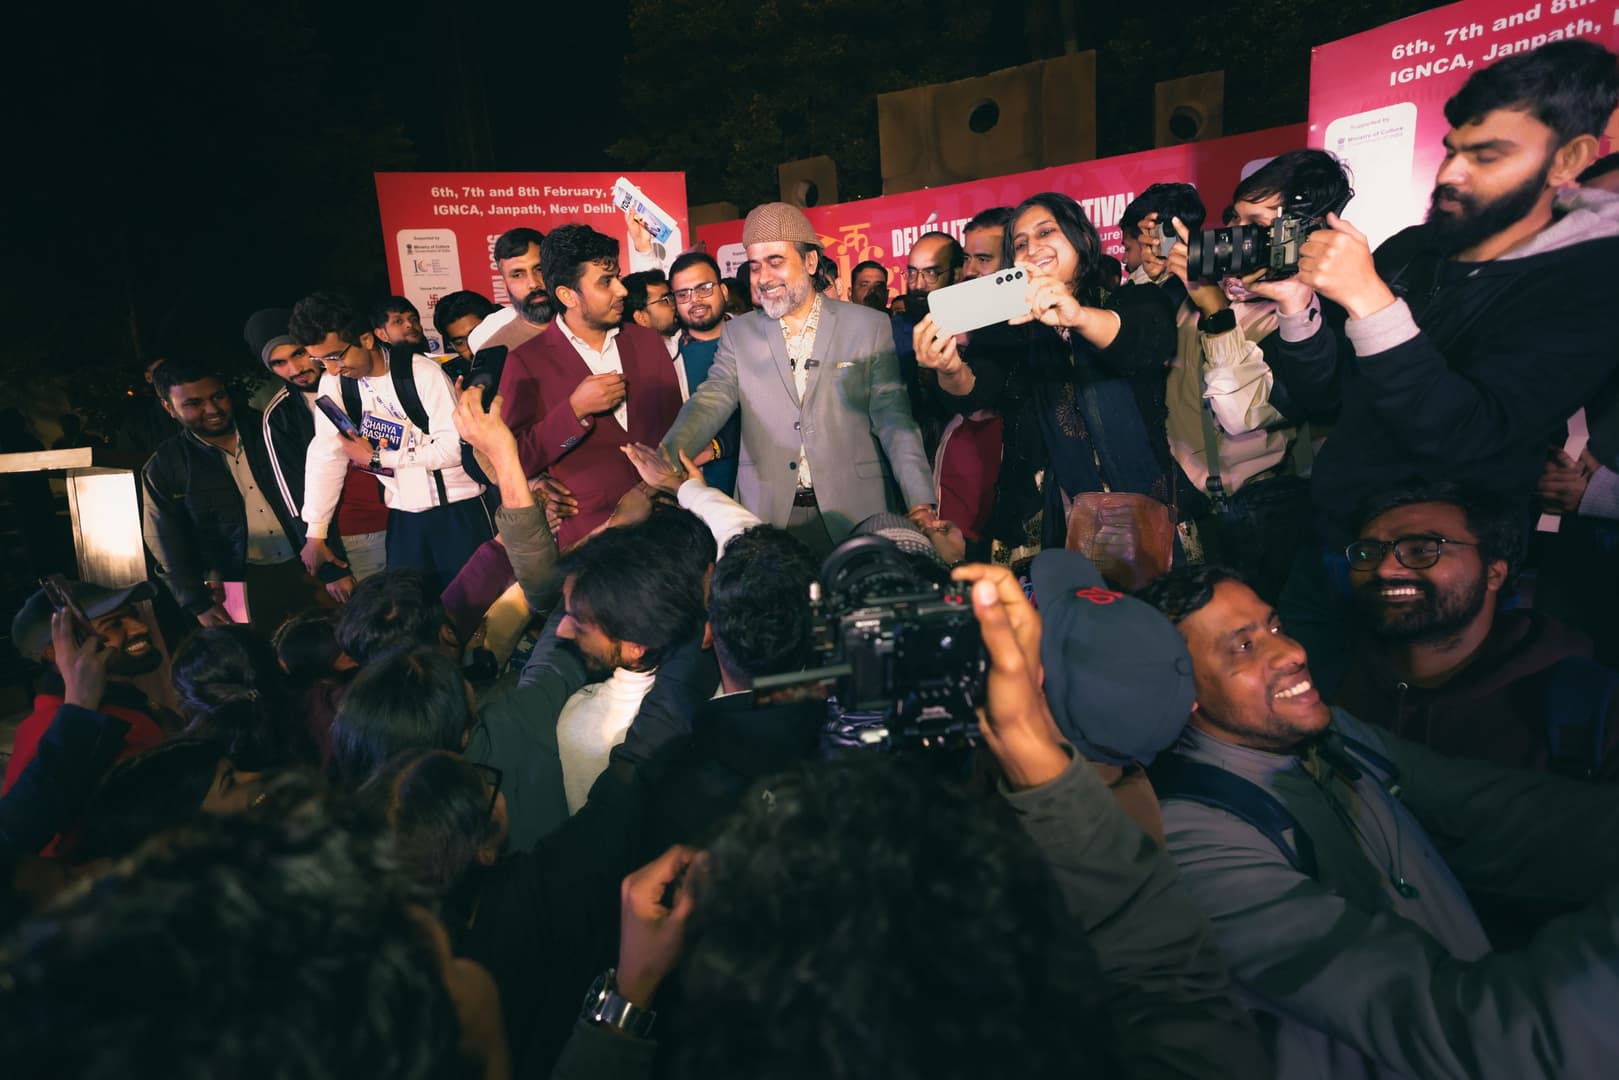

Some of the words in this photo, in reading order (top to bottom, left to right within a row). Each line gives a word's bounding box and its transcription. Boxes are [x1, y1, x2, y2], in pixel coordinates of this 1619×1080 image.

[1391, 38, 1436, 61] 6th,
[1443, 22, 1484, 45] 7th
[1491, 3, 1542, 32] and
[1389, 53, 1474, 87] IGNCA,
[1482, 18, 1602, 62] Janpath,
[431, 186, 459, 199] 6th,
[462, 186, 485, 197] 7th
[489, 186, 514, 197] and
[518, 186, 540, 197] 8th
[543, 186, 607, 200] February,
[433, 204, 484, 217] IGNCA,
[487, 204, 546, 217] Janpath,
[549, 203, 580, 214] New
[583, 203, 616, 214] Delhi
[361, 426, 401, 446] RASHANT
[363, 418, 397, 436] CHARYA
